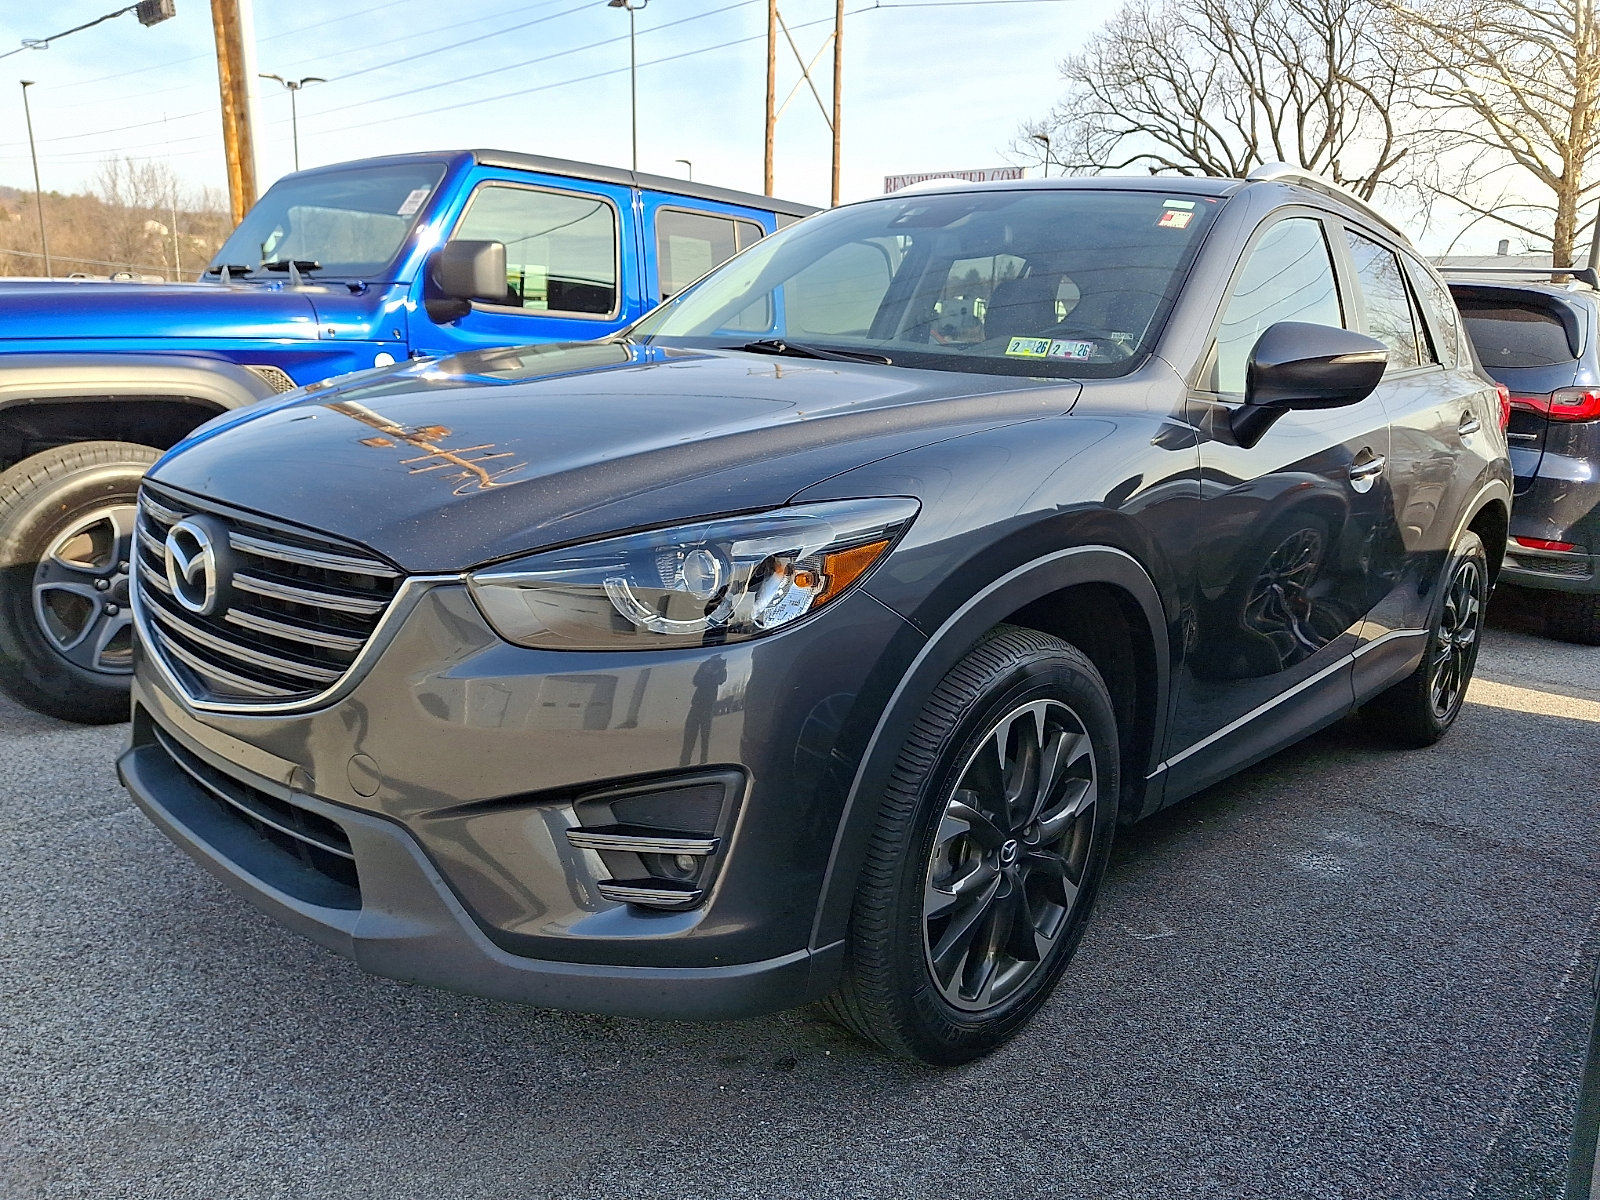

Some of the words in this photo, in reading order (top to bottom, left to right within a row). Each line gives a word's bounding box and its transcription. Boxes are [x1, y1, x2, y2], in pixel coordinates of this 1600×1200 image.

[1013, 342, 1020, 352] 2
[1036, 341, 1048, 353] 26
[1053, 344, 1060, 354] 2
[1078, 344, 1089, 356] 26
